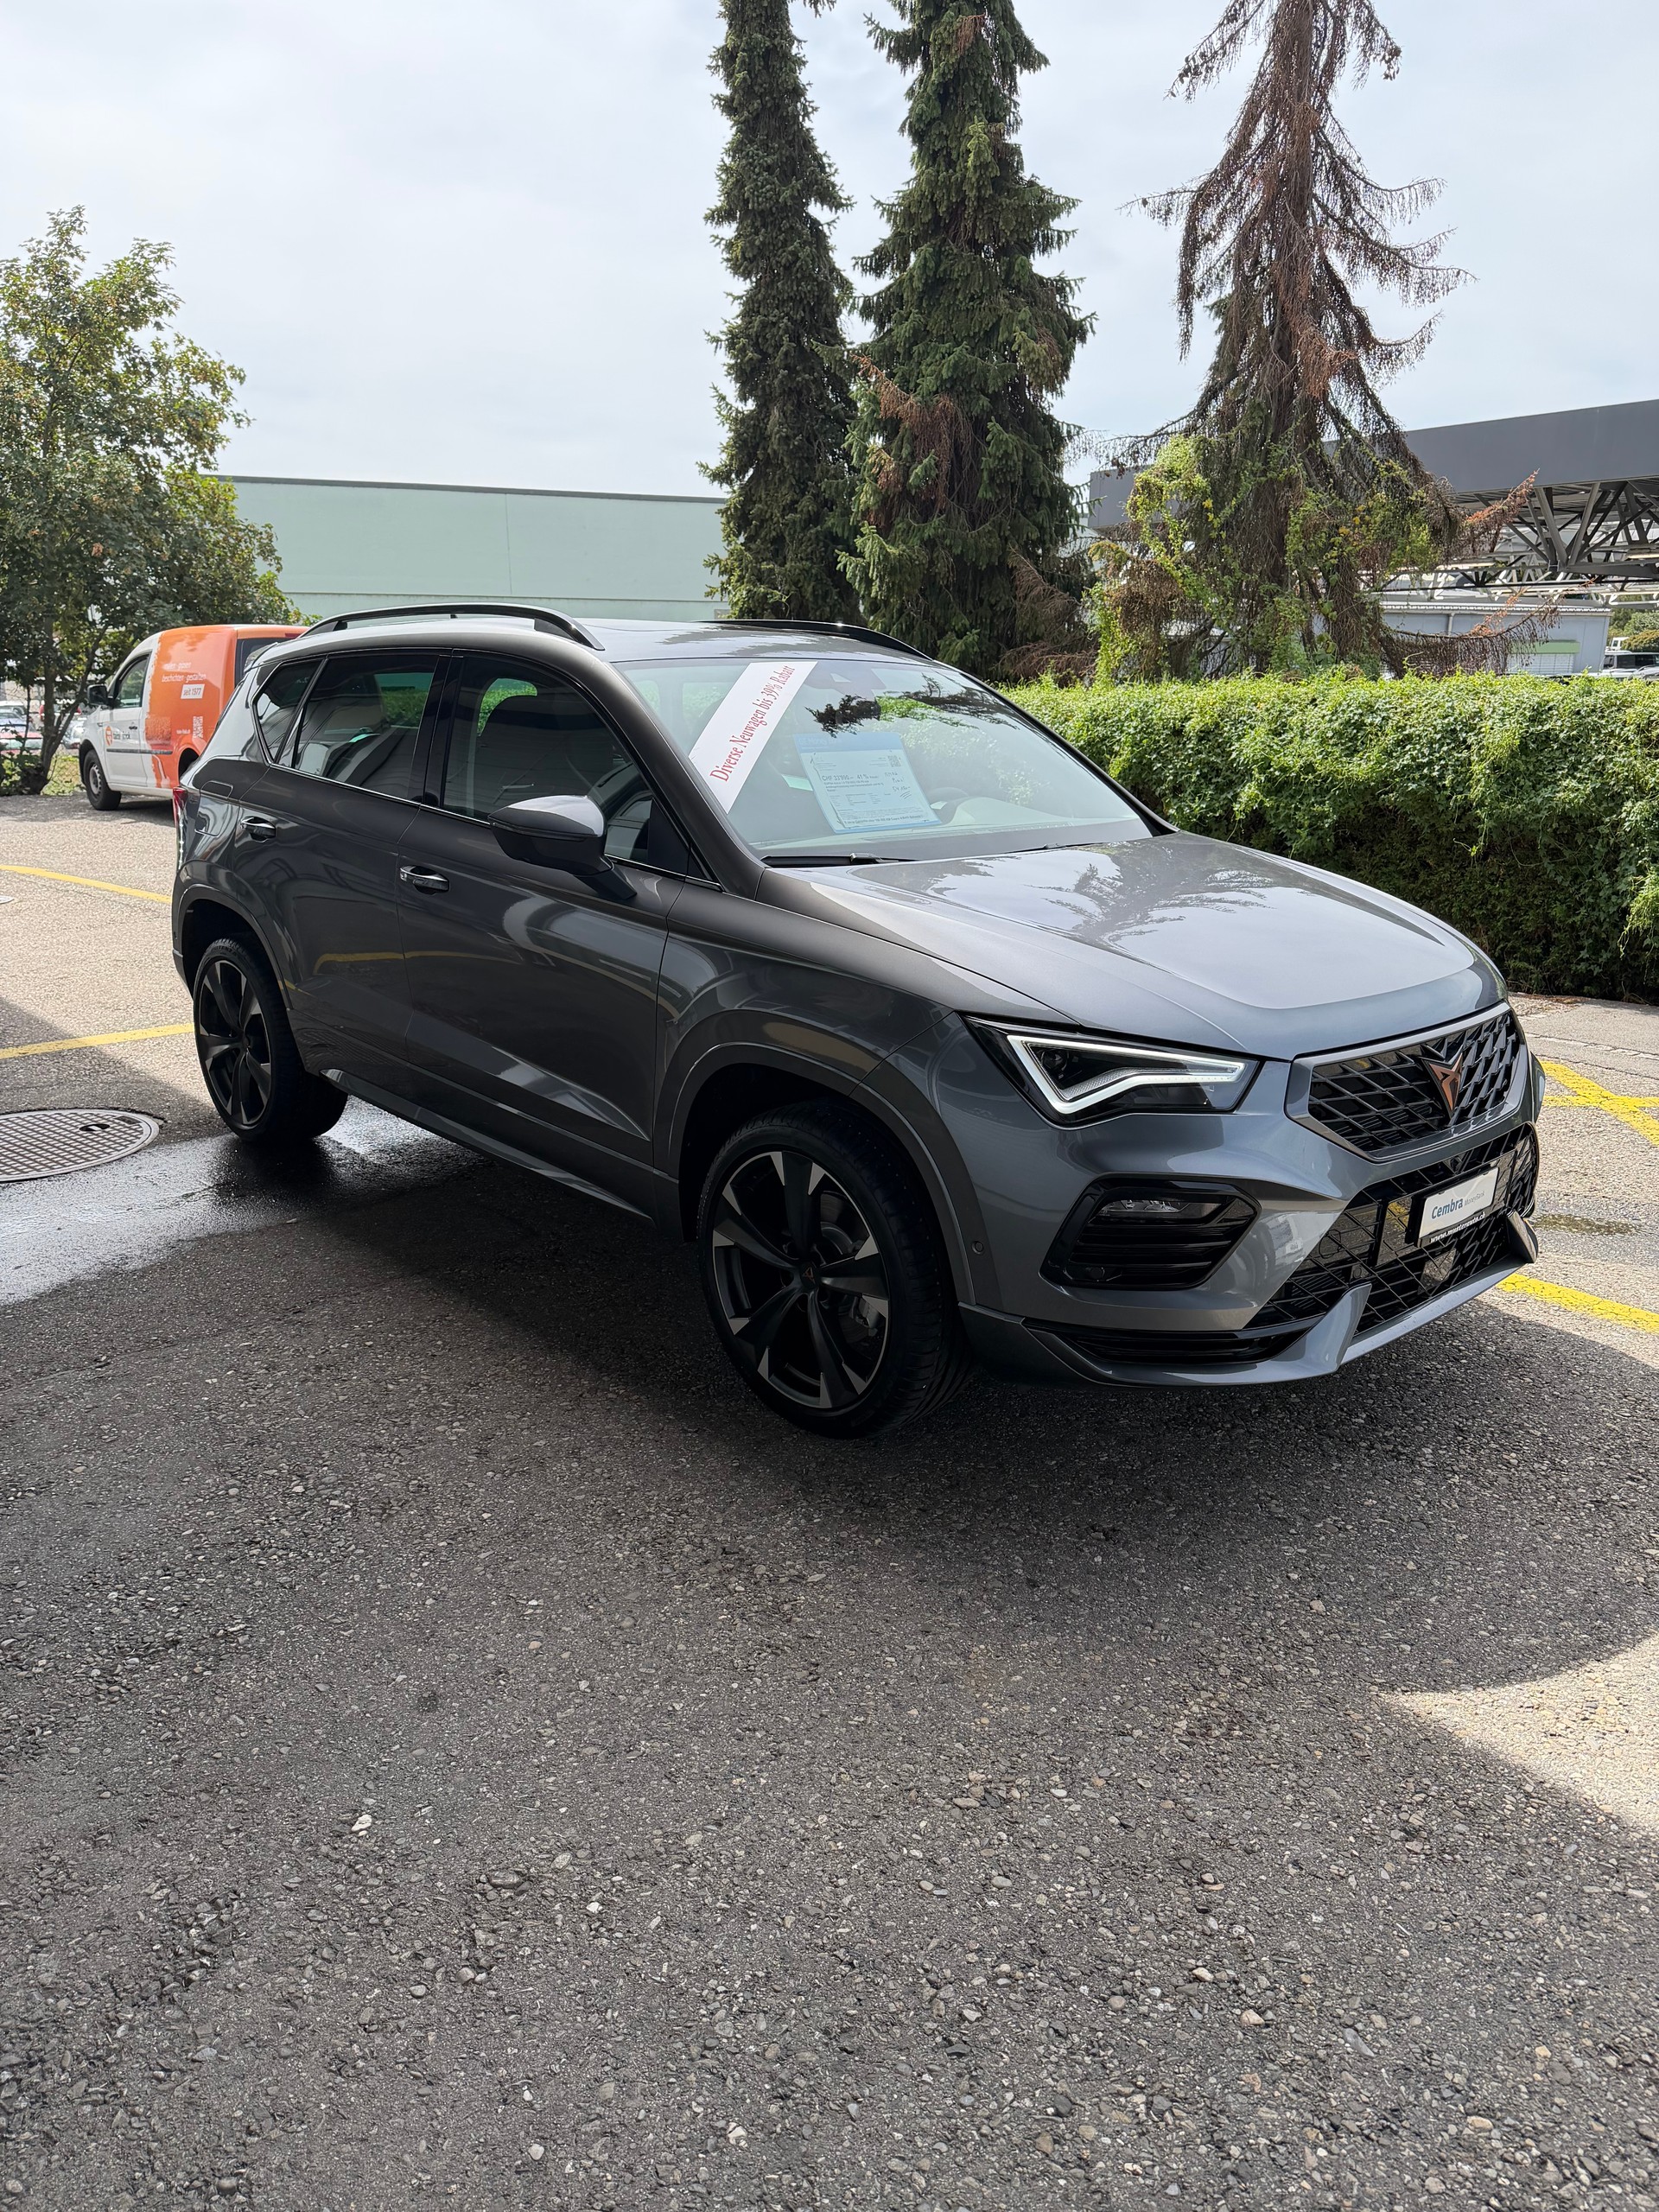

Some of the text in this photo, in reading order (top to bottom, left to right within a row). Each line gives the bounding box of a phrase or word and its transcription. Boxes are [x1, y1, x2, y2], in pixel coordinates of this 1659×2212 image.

[709, 665, 796, 782] Diverse Neuwagen bis 39% Rabatt
[1431, 1198, 1464, 1219] Cembra
